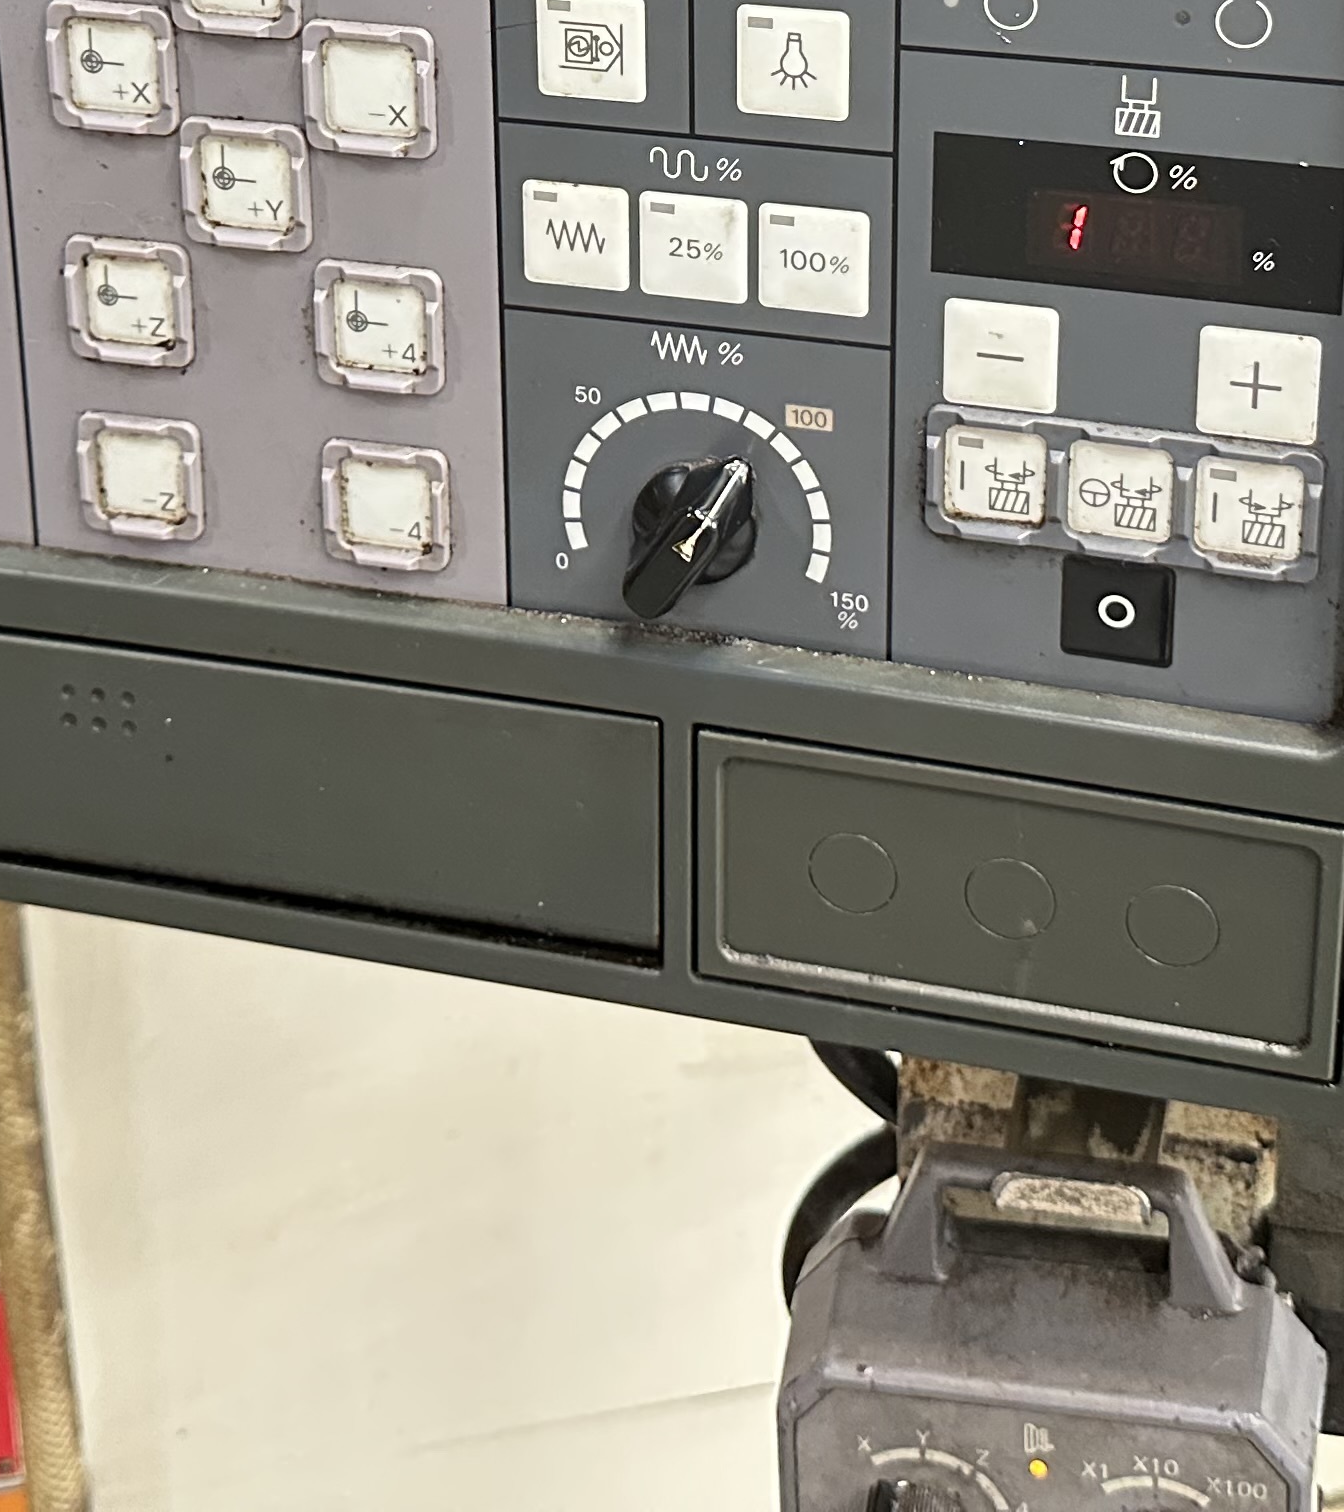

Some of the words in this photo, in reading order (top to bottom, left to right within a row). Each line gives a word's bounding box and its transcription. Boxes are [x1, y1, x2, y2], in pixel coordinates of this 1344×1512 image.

[113, 81, 151, 105] +X
[368, 104, 408, 128] -X
[247, 199, 284, 221] +Y
[668, 236, 724, 262] 25%
[779, 248, 850, 275] 100%
[574, 385, 602, 405] 50
[791, 408, 829, 430] 100
[555, 552, 569, 570] 0
[830, 591, 869, 616] 150
[1082, 1460, 1108, 1479] X1
[1133, 1455, 1179, 1476] X10
[1207, 1477, 1268, 1500] X100
